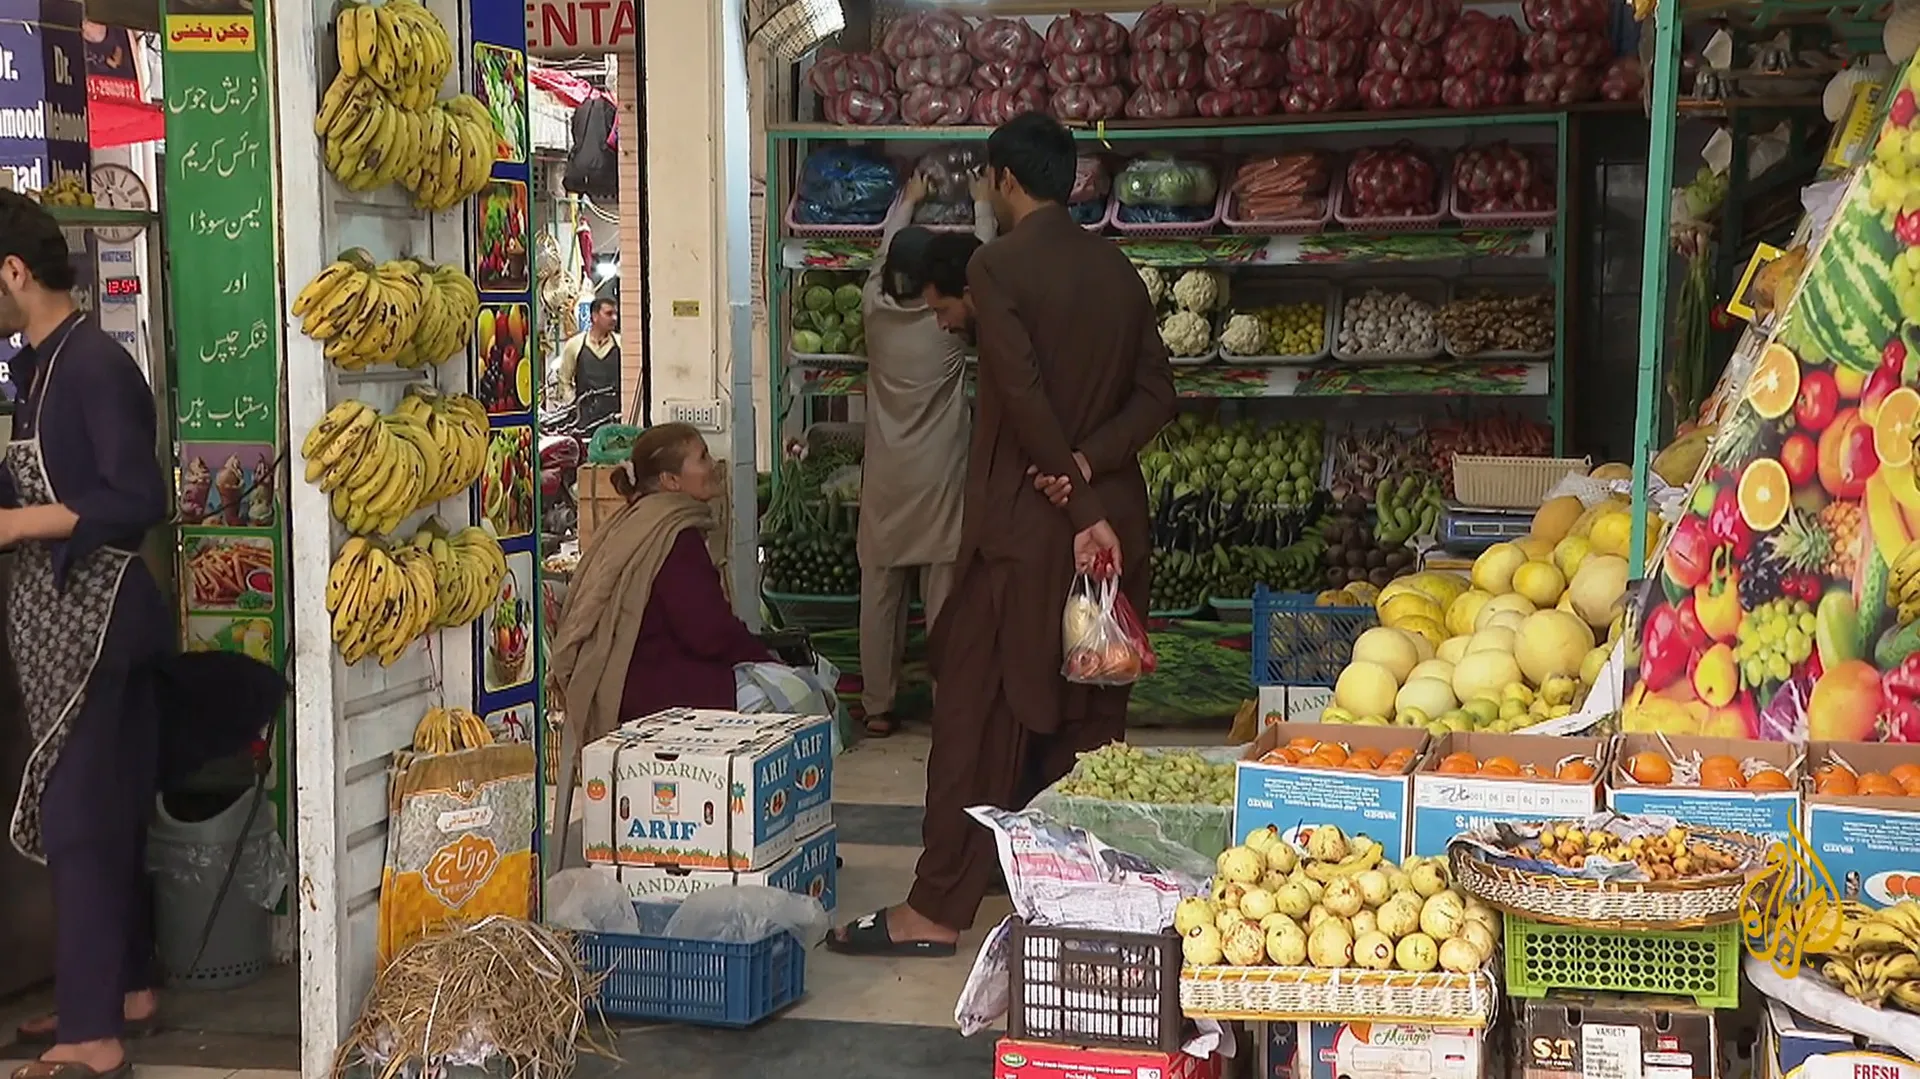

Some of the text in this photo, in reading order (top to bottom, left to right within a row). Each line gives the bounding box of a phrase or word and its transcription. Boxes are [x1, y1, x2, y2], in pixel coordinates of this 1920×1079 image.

[171, 22, 249, 45] چکن یخنی
[53, 45, 73, 85] Dr.
[168, 76, 258, 114] فریش جوس
[181, 131, 260, 180] آئس کریم
[189, 196, 262, 239] لیمن سوڈا
[222, 272, 247, 293] اور
[200, 319, 268, 363] فنگر چپس
[179, 397, 269, 427] دستیاب ہیں
[793, 733, 822, 760] ARIF
[761, 755, 789, 788] ARIF
[628, 818, 697, 840] ARIF
[802, 842, 829, 874] ARIF
[1532, 1037, 1576, 1060] S.T
[1853, 1063, 1900, 1079] FRESH
